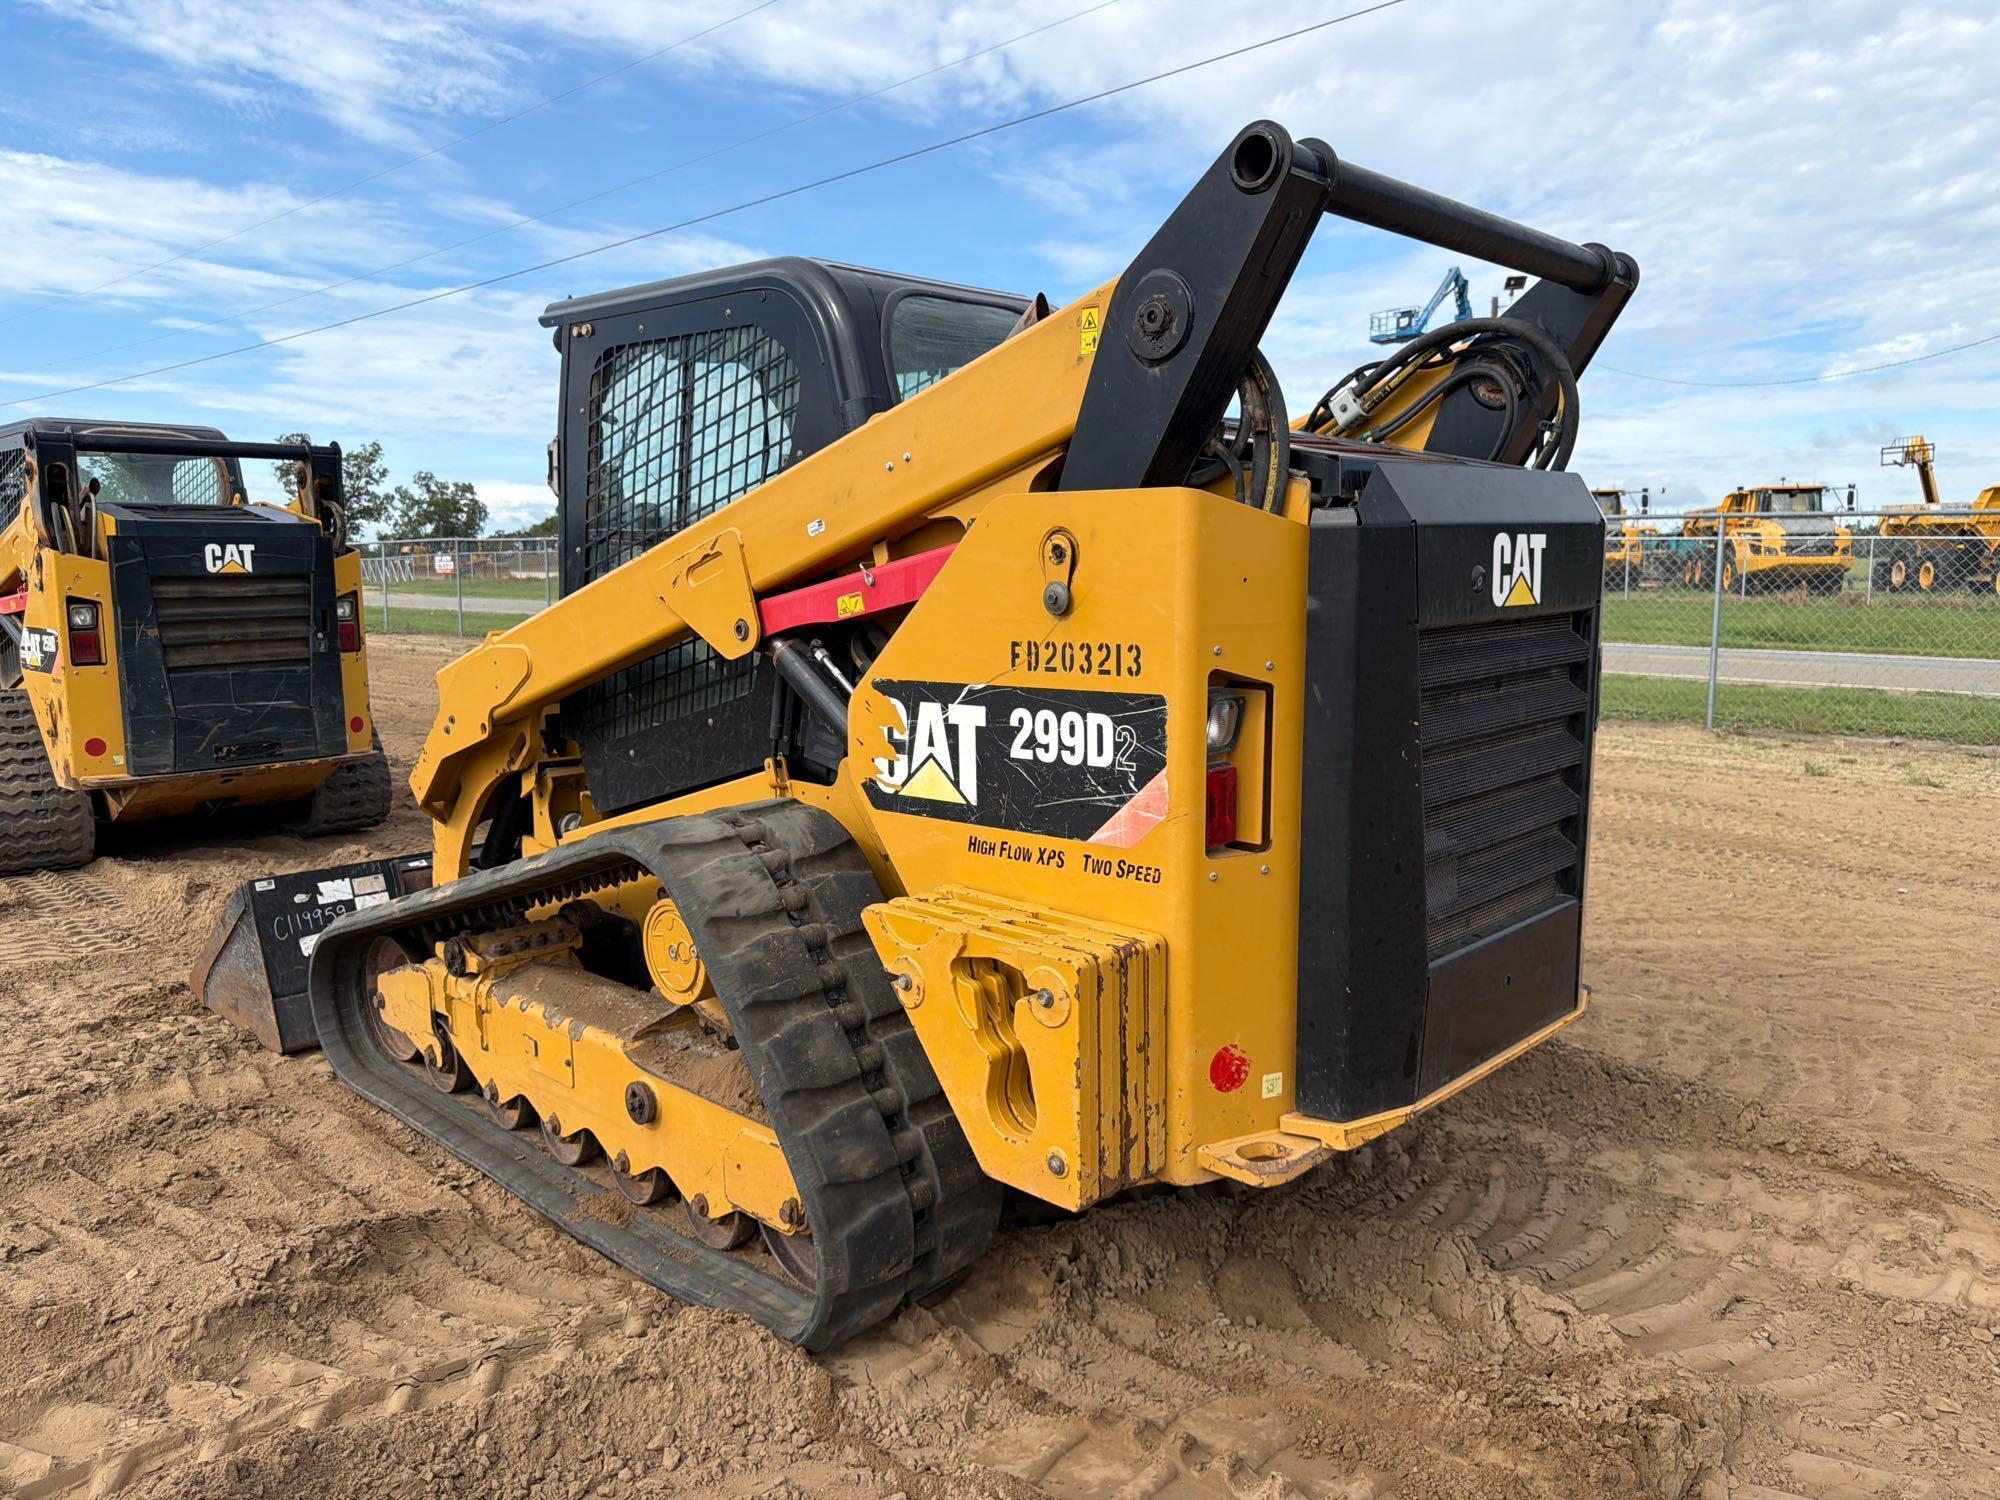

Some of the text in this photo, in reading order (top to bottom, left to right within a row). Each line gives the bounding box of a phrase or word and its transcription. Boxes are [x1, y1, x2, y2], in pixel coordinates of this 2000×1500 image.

[204, 543, 256, 574] CAT
[1492, 532, 1547, 607] CAT
[1010, 639, 1142, 677] FD203213
[1036, 847, 1066, 868] XPS
